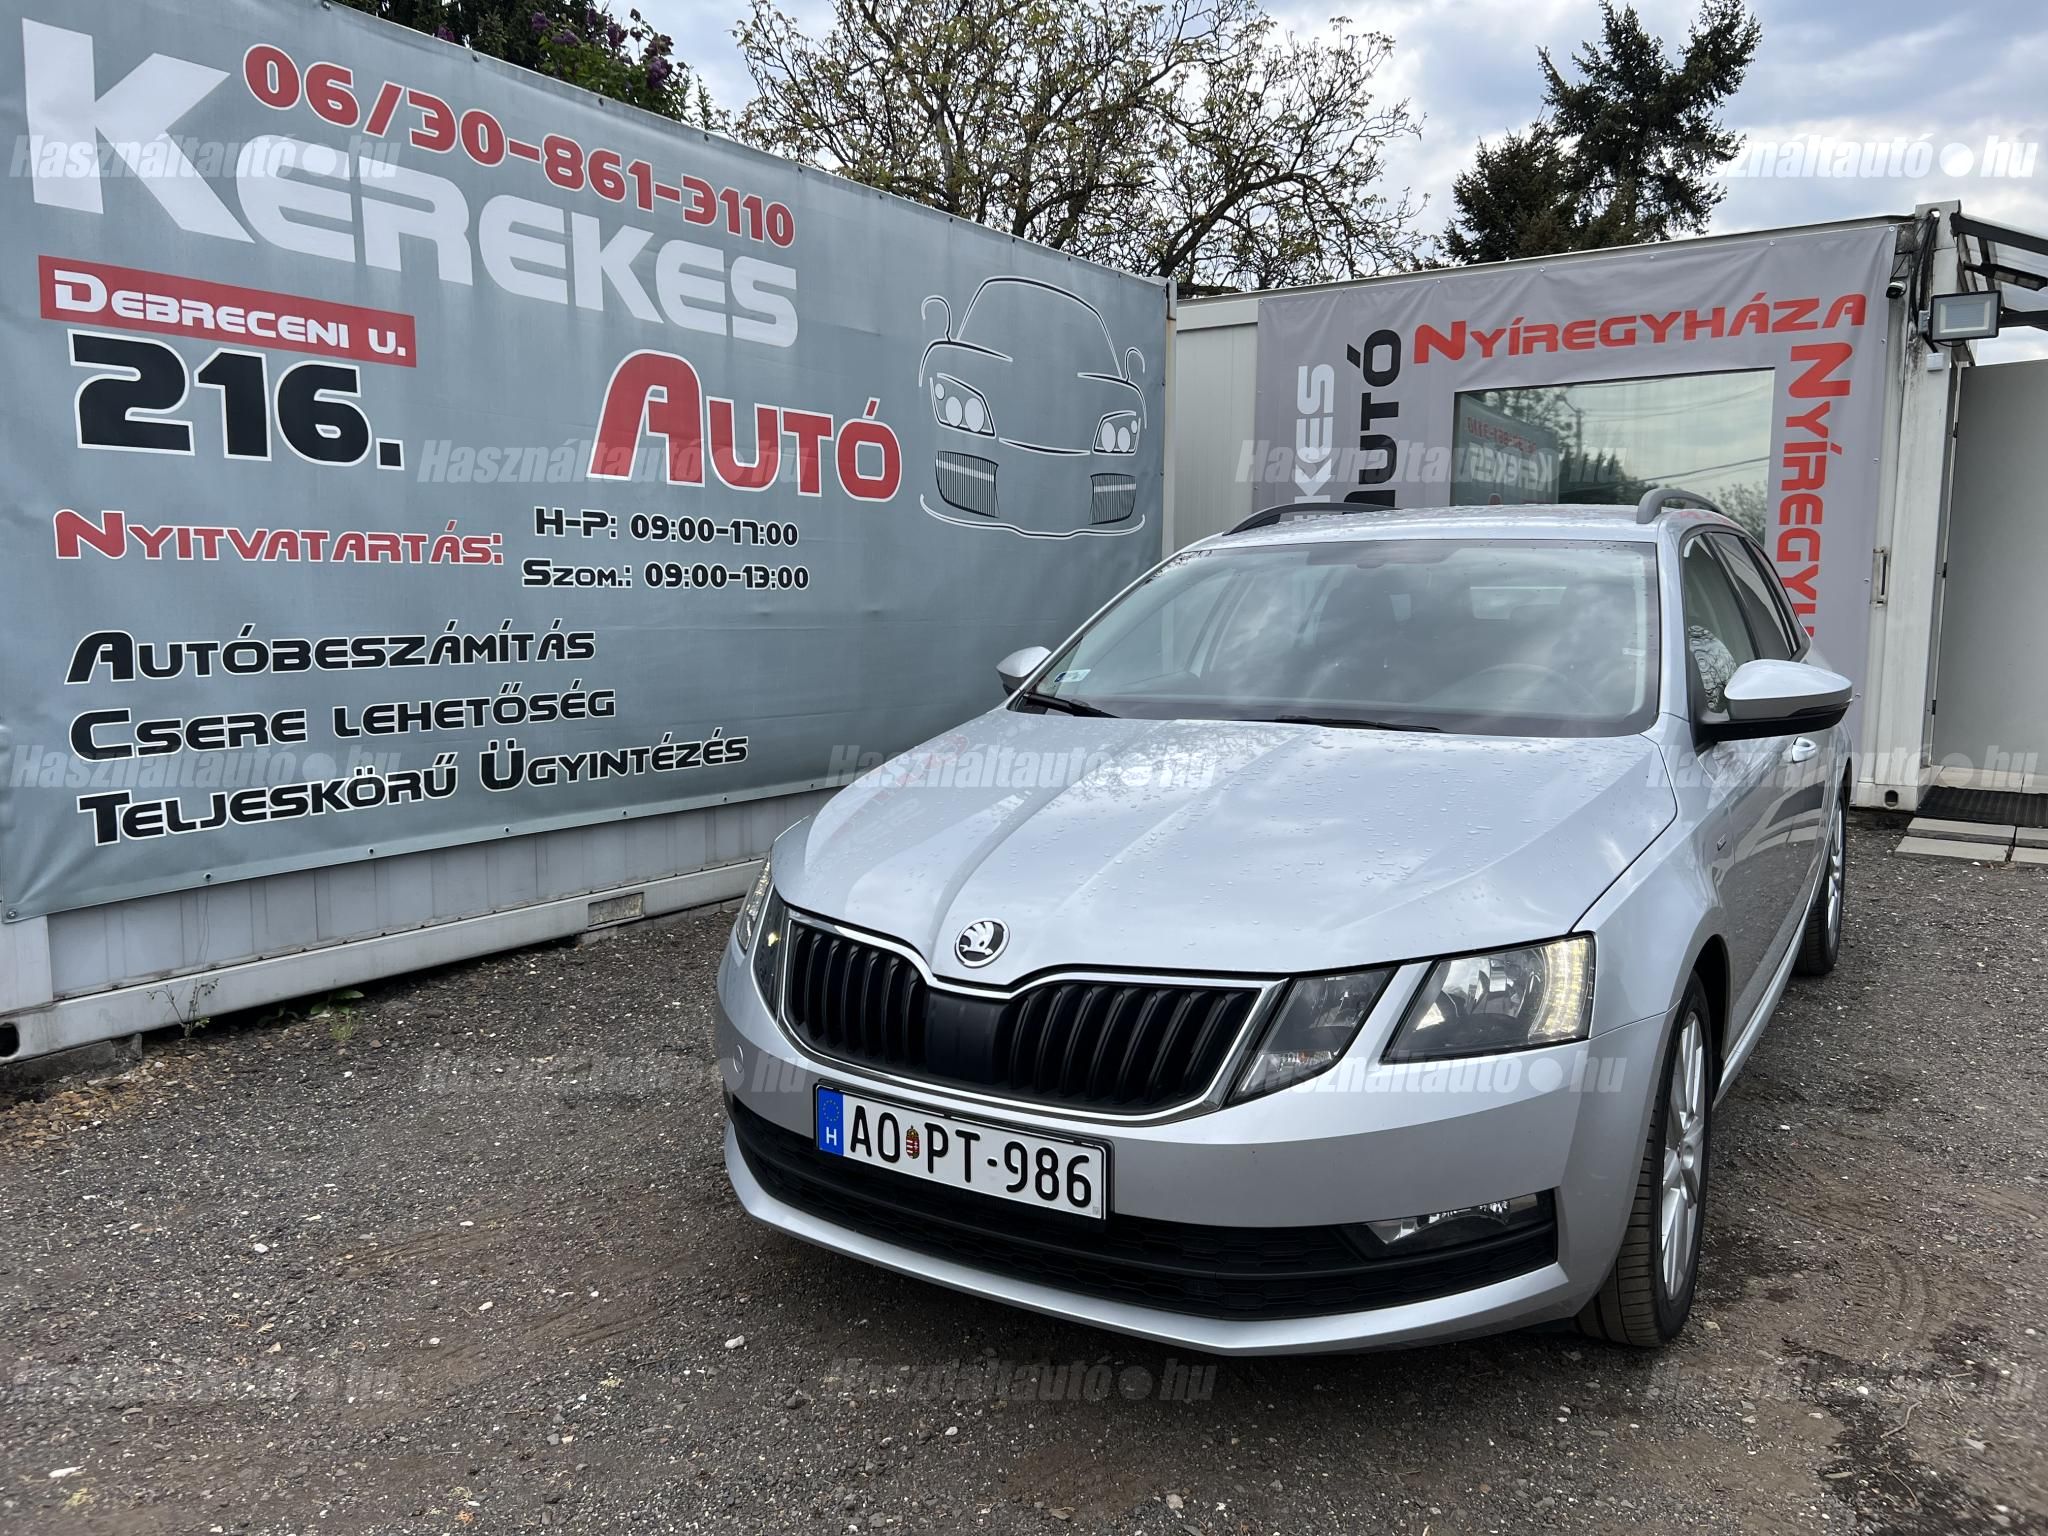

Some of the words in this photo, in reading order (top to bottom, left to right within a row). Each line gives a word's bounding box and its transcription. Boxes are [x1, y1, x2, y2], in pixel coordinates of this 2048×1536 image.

[243, 43, 796, 249] 06/30-861-3110
[54, 269, 350, 346] DEBRECENI
[1413, 292, 1867, 365] NYÍREGYHÁZA
[68, 329, 405, 470] 216.
[587, 348, 901, 503] AUTÓ
[52, 509, 504, 566] NYITVATARTÁS:
[534, 506, 618, 540] H-P:
[630, 512, 799, 547] 09:00-17:00
[644, 562, 810, 590] 09:00-13:00
[64, 618, 596, 685] AUTÓBESZÁMÍTÁS
[68, 707, 309, 763] CSERE
